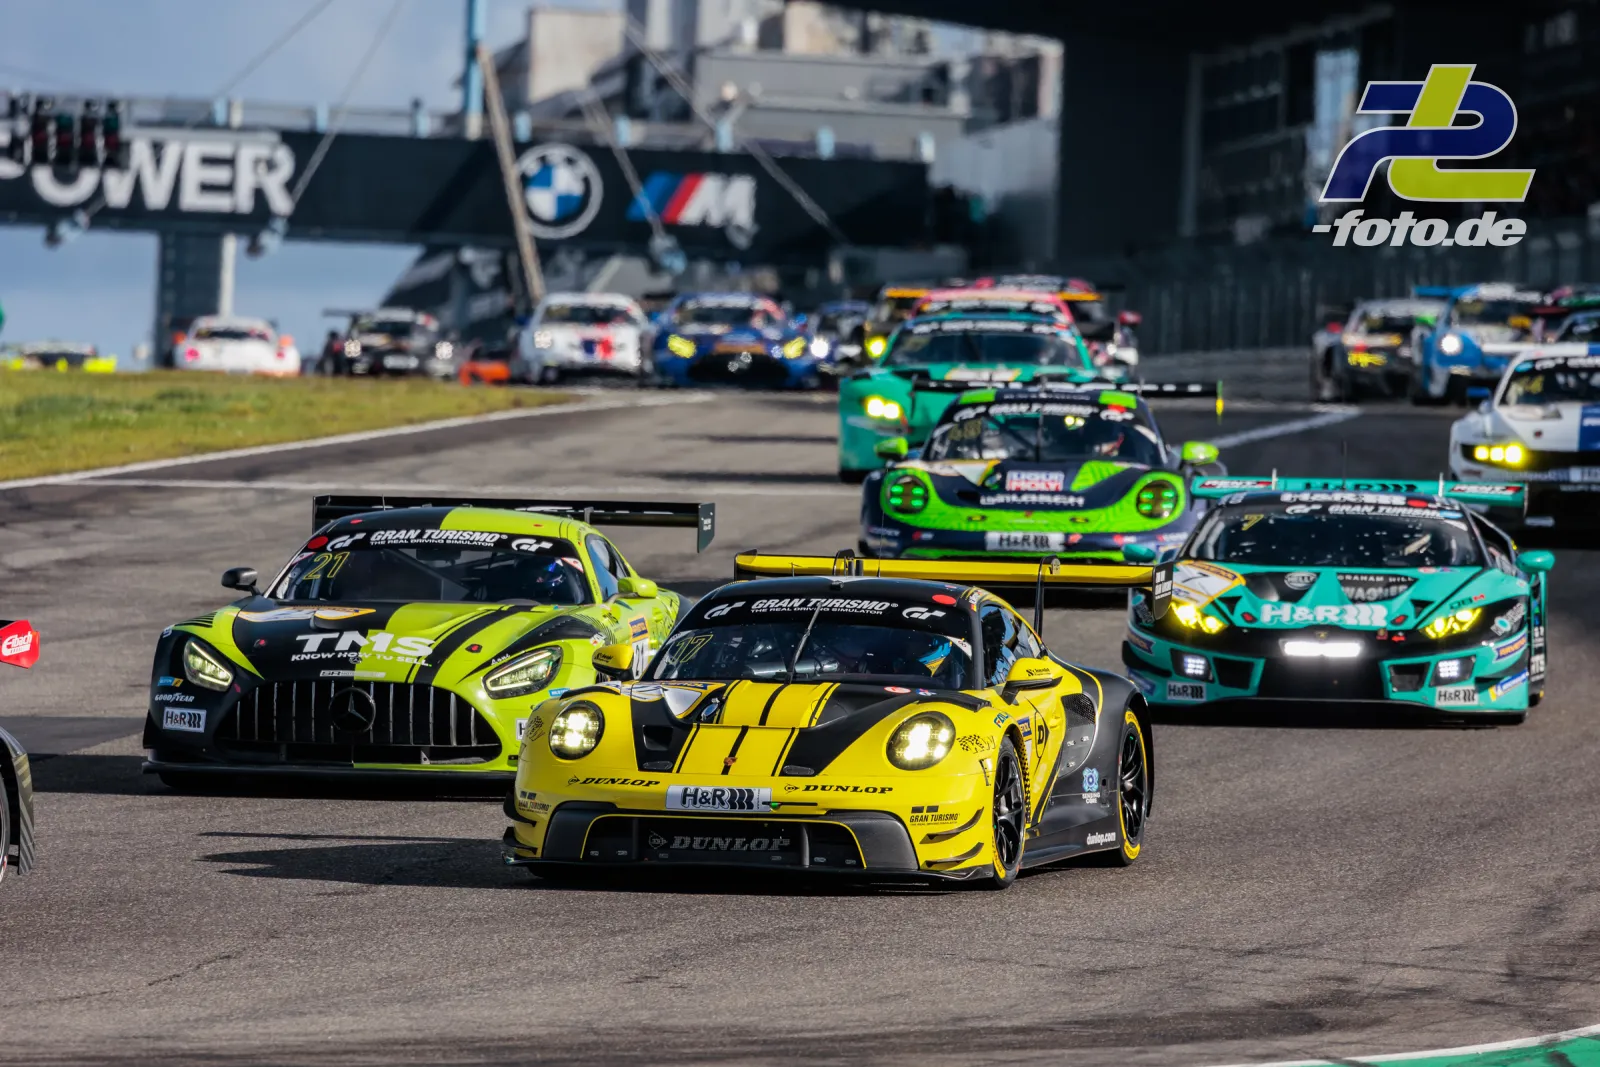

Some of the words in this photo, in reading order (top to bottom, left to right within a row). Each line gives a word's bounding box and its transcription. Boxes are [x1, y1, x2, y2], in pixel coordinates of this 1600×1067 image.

[1328, 504, 1371, 514] GRAN
[370, 529, 421, 541] GRAN
[303, 551, 350, 580] 21
[1337, 574, 1384, 582] GRAHAM
[751, 598, 805, 609] GRAN
[831, 607, 883, 615] SIMULATOR
[295, 630, 436, 657] TMS
[666, 633, 714, 665] 17
[291, 652, 335, 661] KNOW
[337, 651, 372, 659] HOW
[154, 692, 195, 703] GOODYEAR
[579, 777, 660, 787] DUNLOP
[801, 784, 893, 794] DUNLOP
[910, 814, 928, 823] GRAN
[669, 835, 791, 851] DUNLOP
[1086, 832, 1116, 845] dunlop.com
